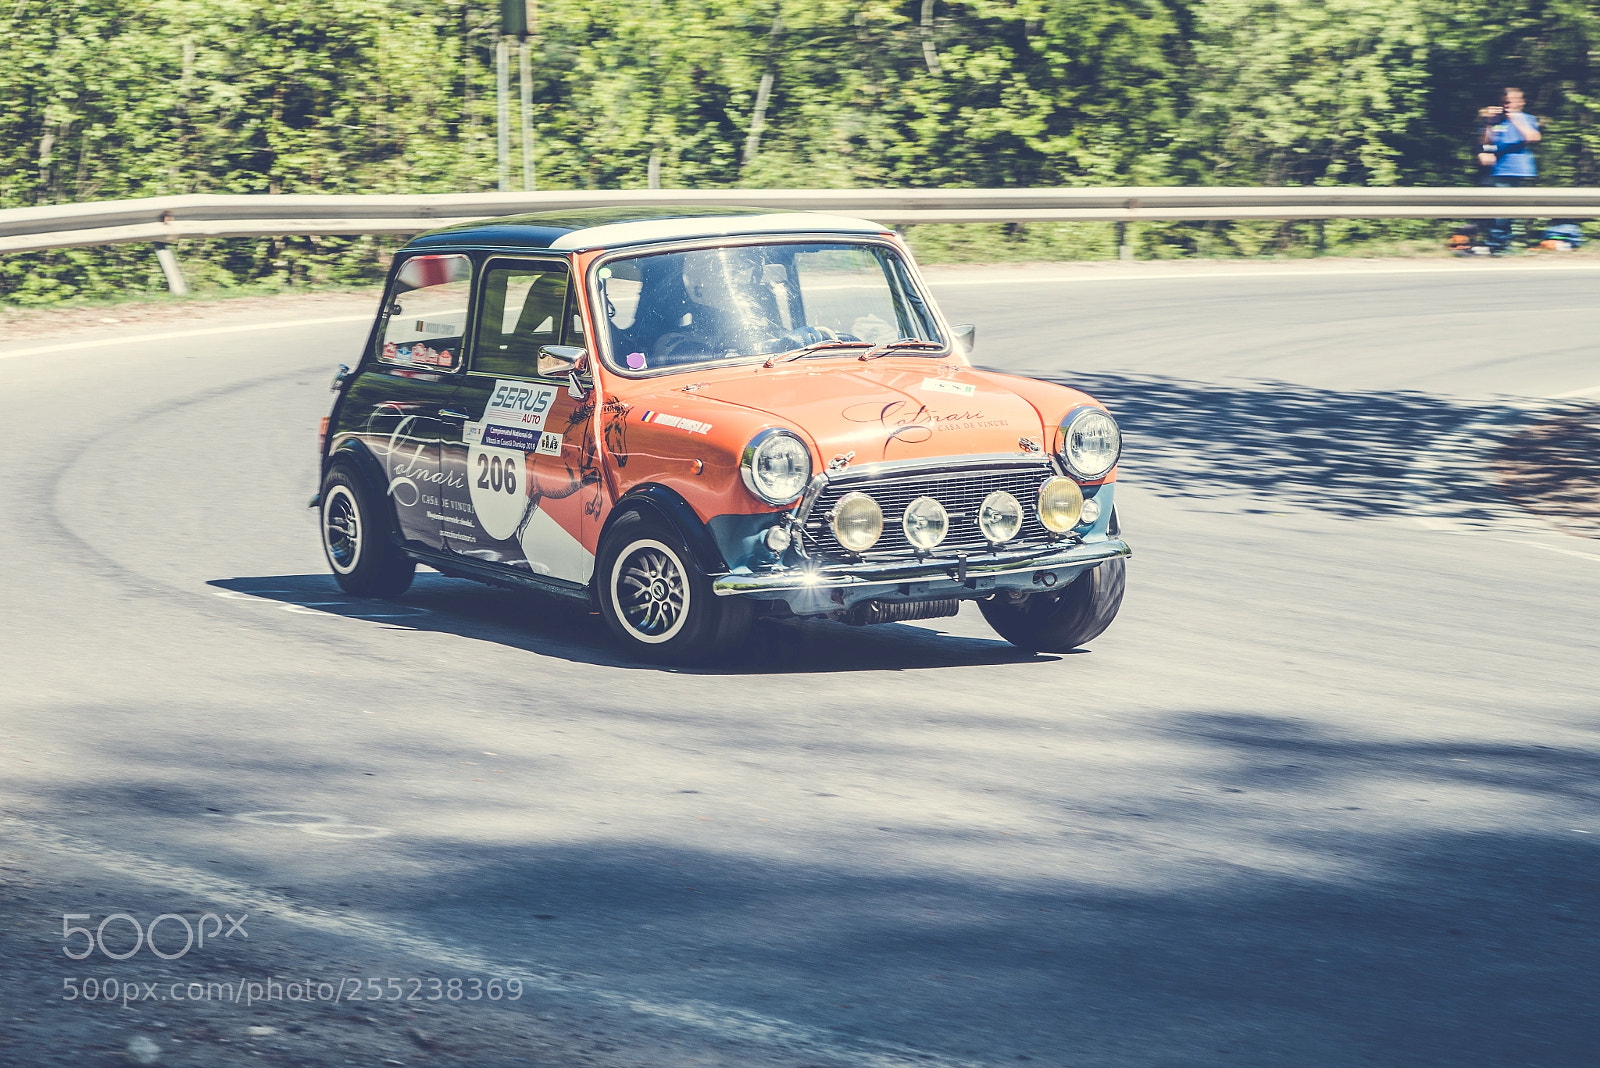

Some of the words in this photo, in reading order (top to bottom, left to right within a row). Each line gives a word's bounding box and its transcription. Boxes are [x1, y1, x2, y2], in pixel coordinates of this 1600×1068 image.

[491, 385, 552, 413] SERUS
[521, 413, 541, 425] AUTO
[938, 424, 959, 432] CASA
[964, 421, 976, 429] DE
[979, 419, 1009, 428] VINURI
[512, 439, 526, 450] Dunlop
[477, 453, 517, 495] 206
[421, 494, 439, 506] CASA
